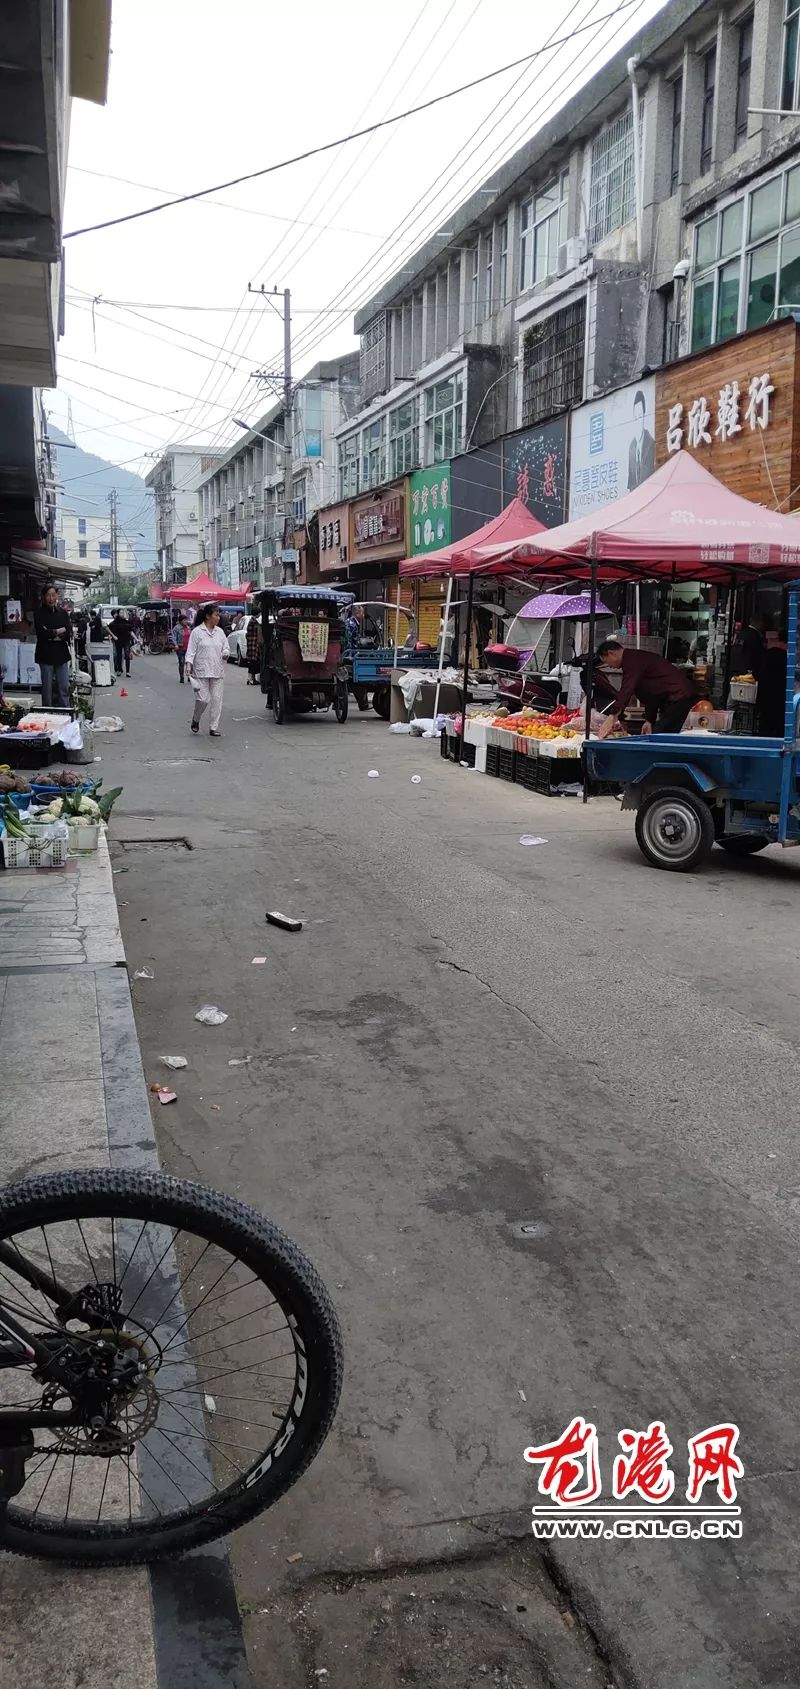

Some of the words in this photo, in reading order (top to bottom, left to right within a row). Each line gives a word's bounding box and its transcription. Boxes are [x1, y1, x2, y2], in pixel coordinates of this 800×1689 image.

[667, 373, 774, 453] 吕欣鞋行
[597, 486, 618, 502] SHOES
